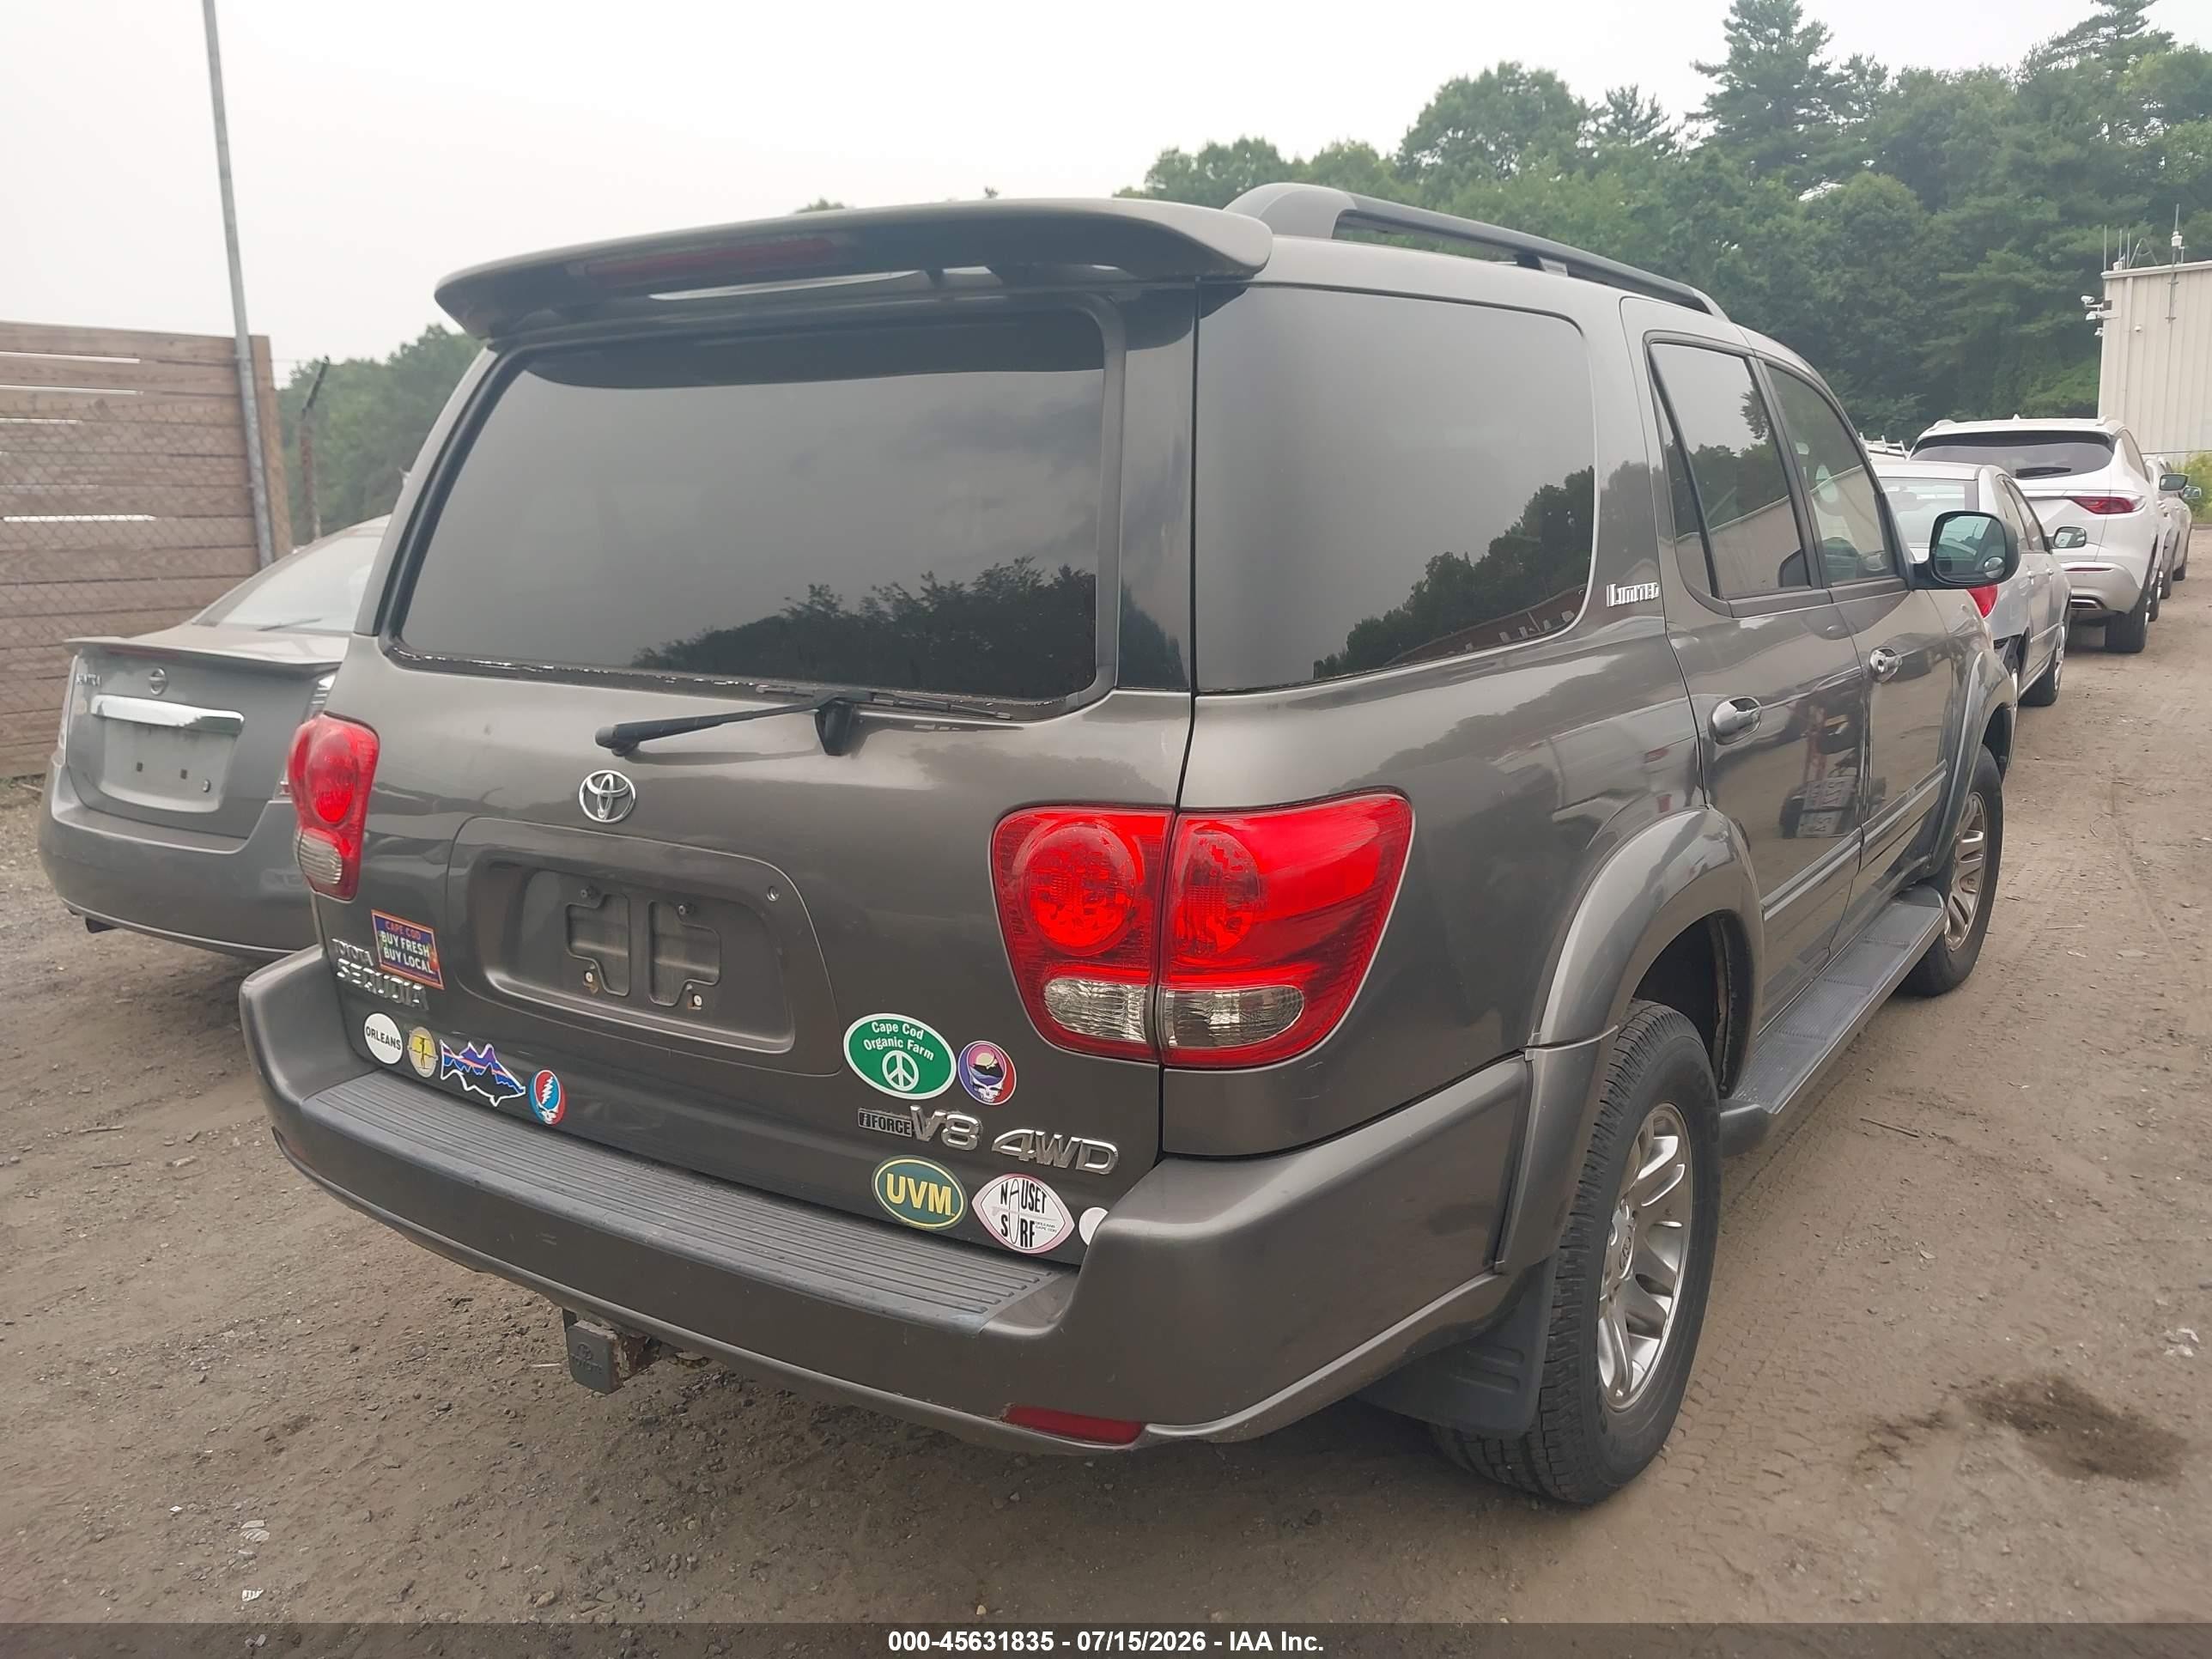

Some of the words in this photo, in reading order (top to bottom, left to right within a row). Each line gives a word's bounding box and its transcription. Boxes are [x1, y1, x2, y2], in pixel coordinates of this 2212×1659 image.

[381, 931, 399, 947] BUY
[400, 937, 430, 957] FRESH
[383, 946, 402, 963] BUY
[403, 953, 436, 975] LOCAL
[366, 1025, 402, 1051] ORLEANS
[871, 1021, 899, 1035] Cape
[902, 1023, 925, 1041] Cod
[863, 1036, 904, 1051] Organic
[907, 1039, 935, 1061] Farm
[910, 1105, 982, 1151] V8
[992, 1128, 1119, 1175] 4WD
[886, 1173, 952, 1217] UVM
